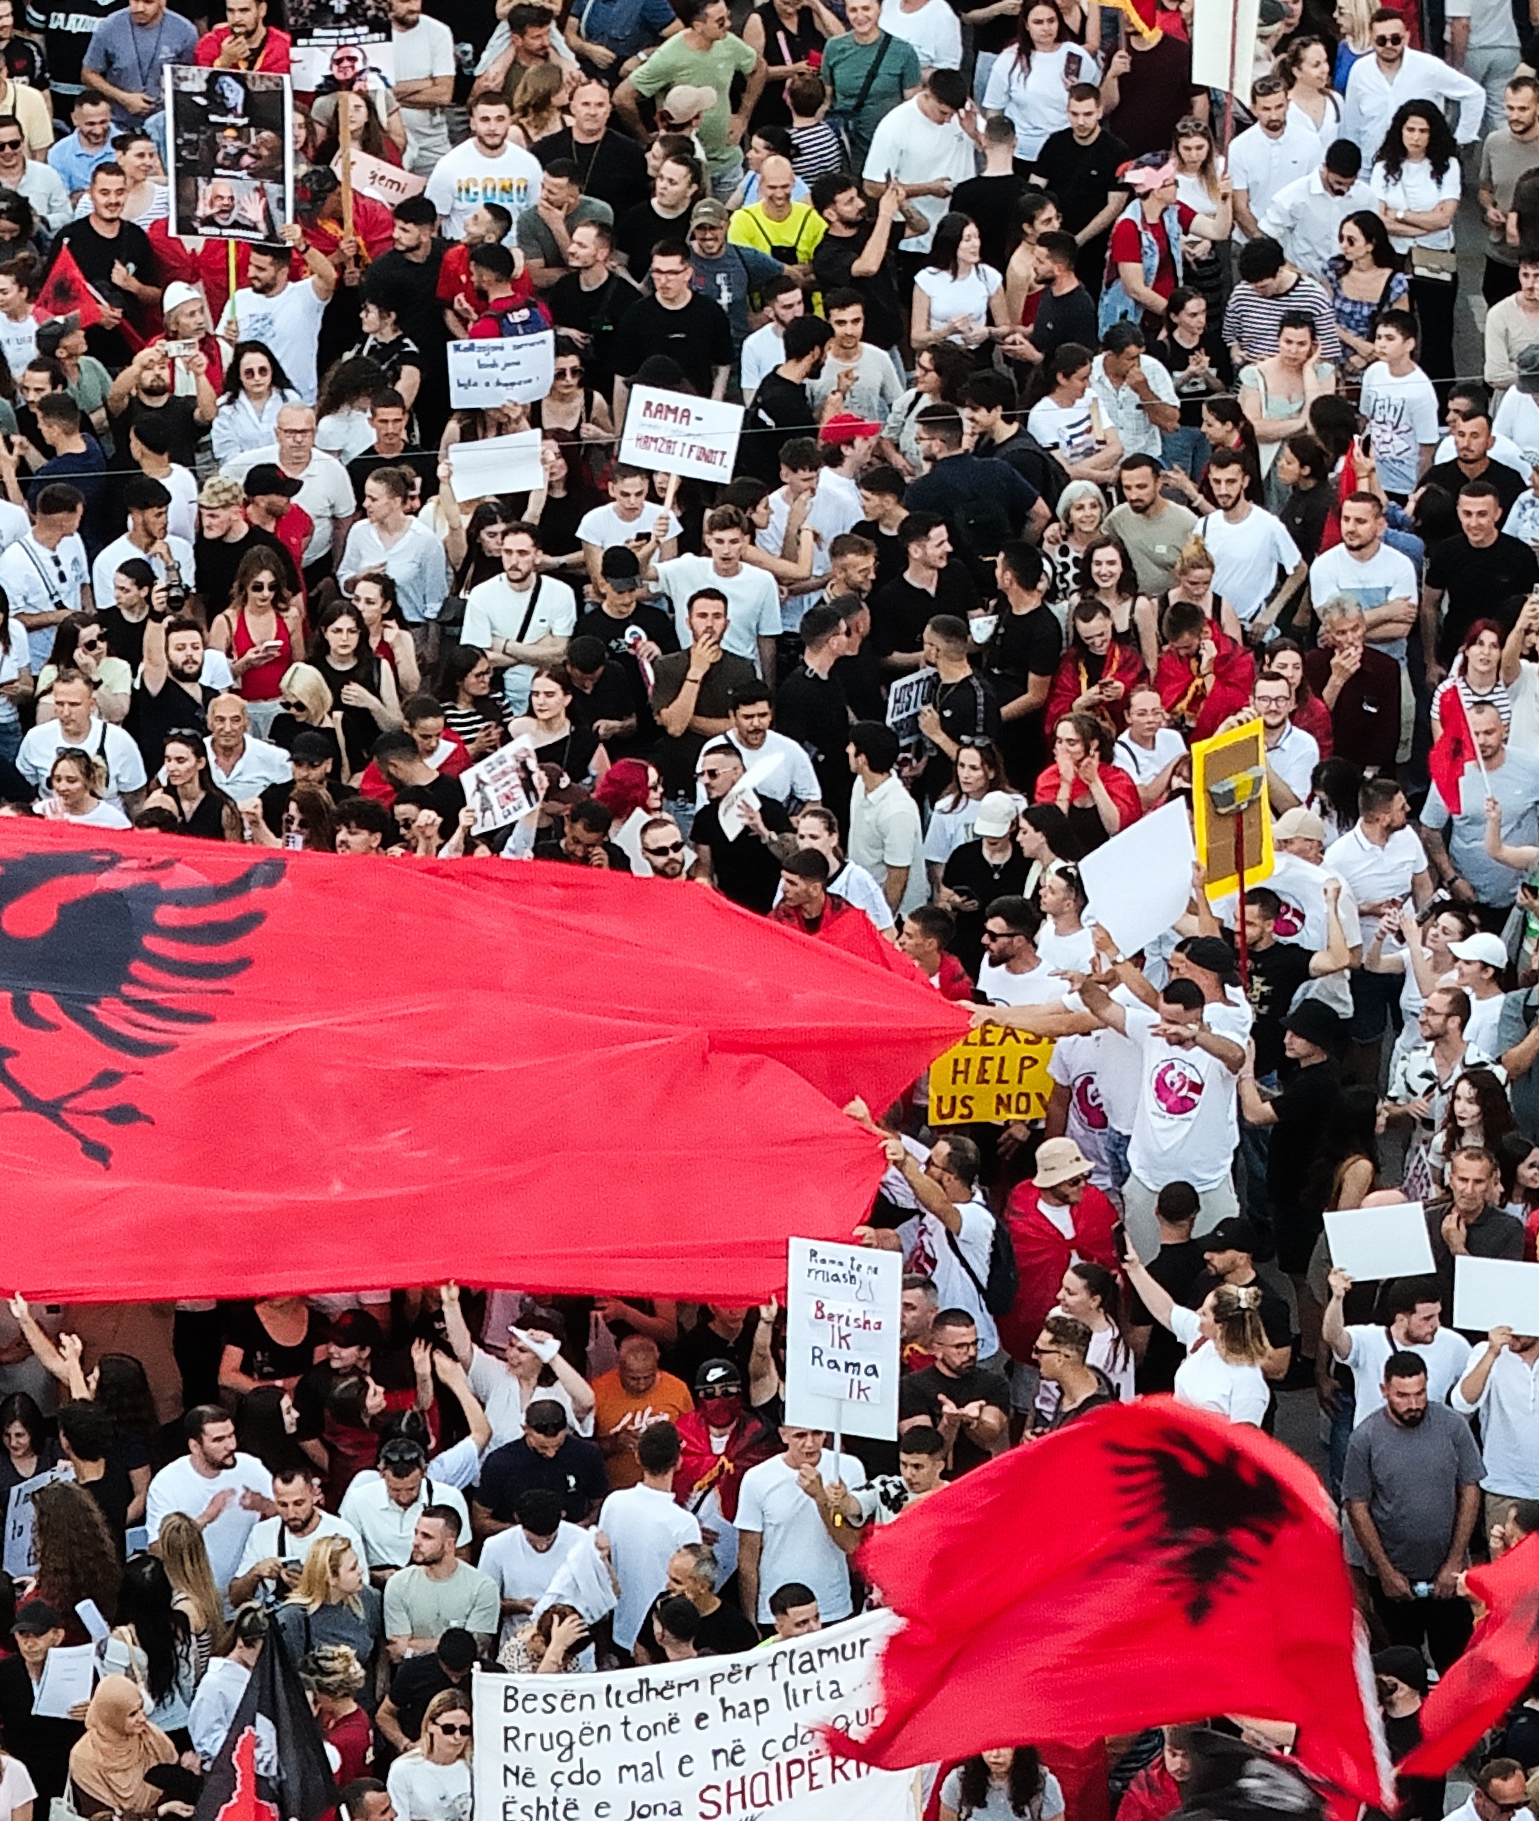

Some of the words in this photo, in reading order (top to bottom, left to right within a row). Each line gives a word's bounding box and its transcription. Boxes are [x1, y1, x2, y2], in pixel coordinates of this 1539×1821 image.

[642, 400, 691, 426] RAMA
[951, 1056, 1039, 1085] HELP
[936, 1094, 975, 1120] US
[814, 1299, 883, 1332] Berisha
[811, 1346, 880, 1379] Rama
[503, 1683, 596, 1714] Besën
[710, 1660, 754, 1697] për
[503, 1723, 611, 1763] Rrugën
[622, 1711, 682, 1741] tonë
[694, 1707, 710, 1731] e
[721, 1692, 769, 1726] hap
[502, 1763, 537, 1789] Në
[617, 1751, 666, 1784] mal
[677, 1754, 695, 1779] e
[712, 1740, 746, 1772] në
[594, 1801, 612, 1818] e
